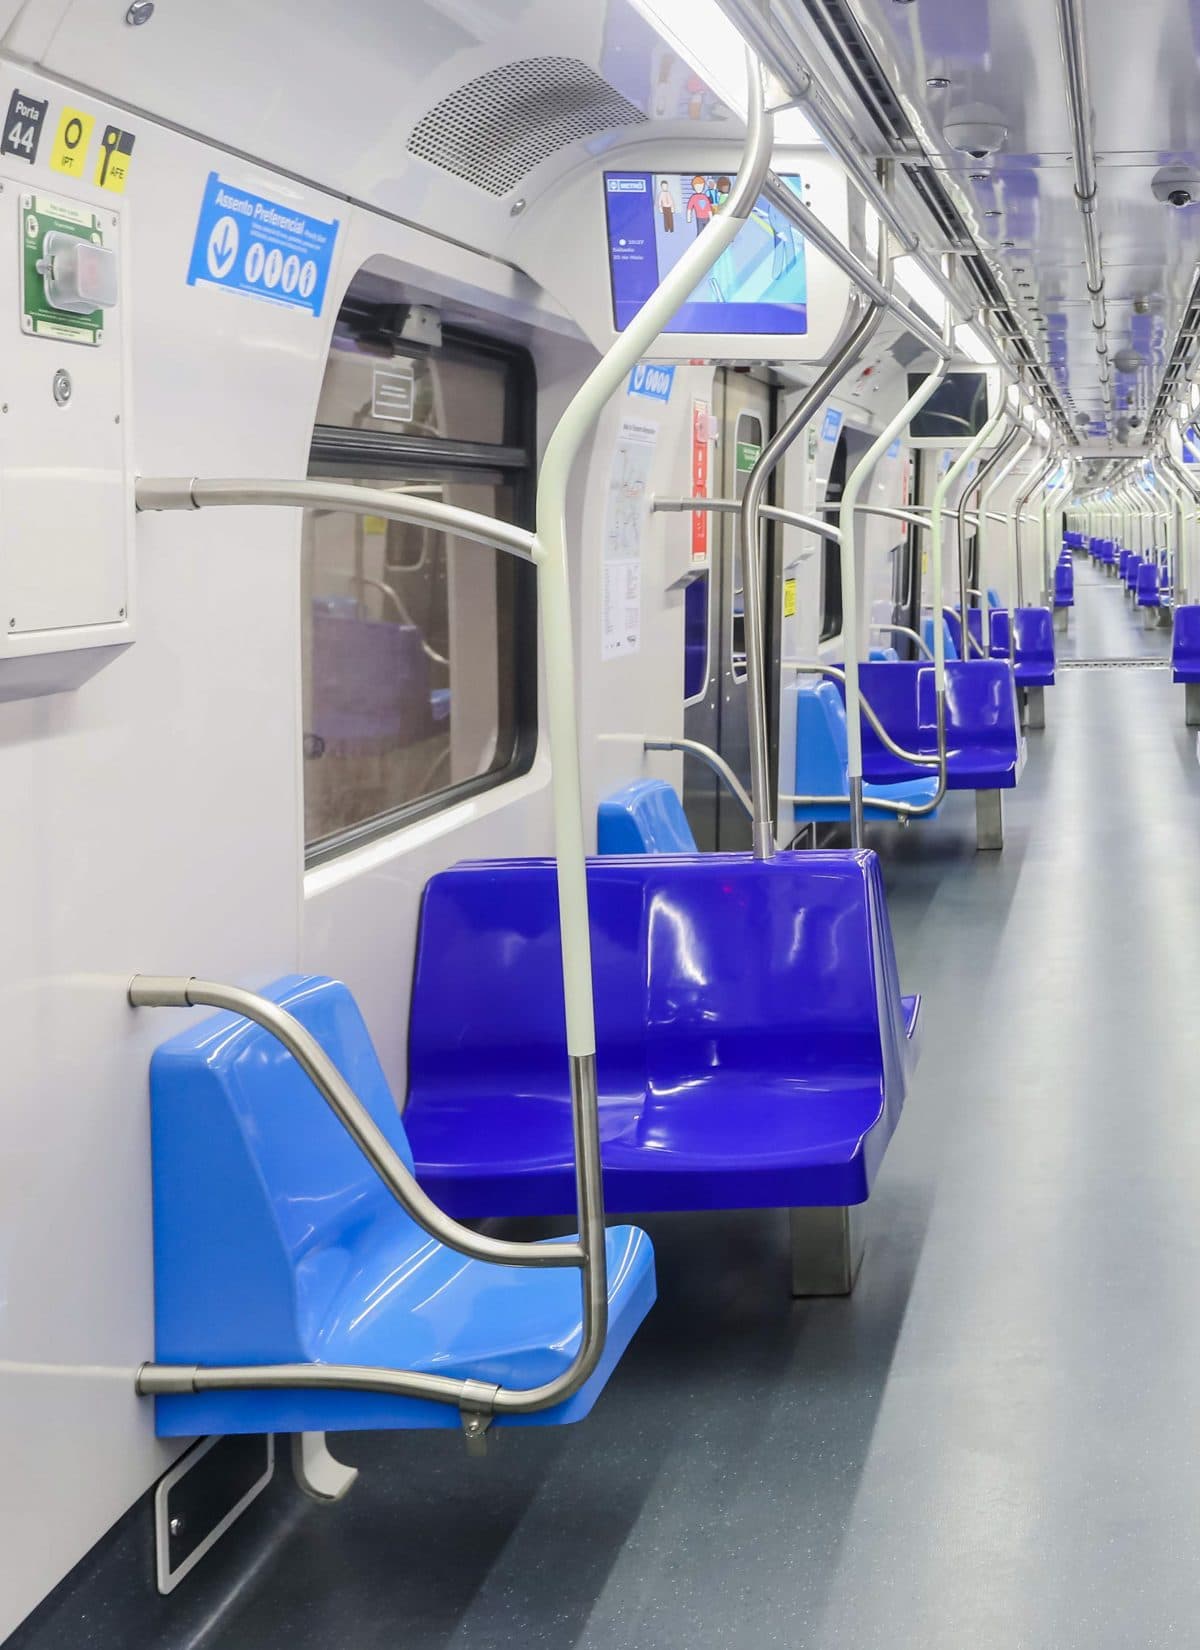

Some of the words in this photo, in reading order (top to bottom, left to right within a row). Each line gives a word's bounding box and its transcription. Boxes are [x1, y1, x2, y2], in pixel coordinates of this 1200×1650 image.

[15, 101, 39, 120] Porta
[8, 122, 35, 153] 44
[215, 188, 254, 217] Assento
[253, 202, 306, 235] Preferencial
